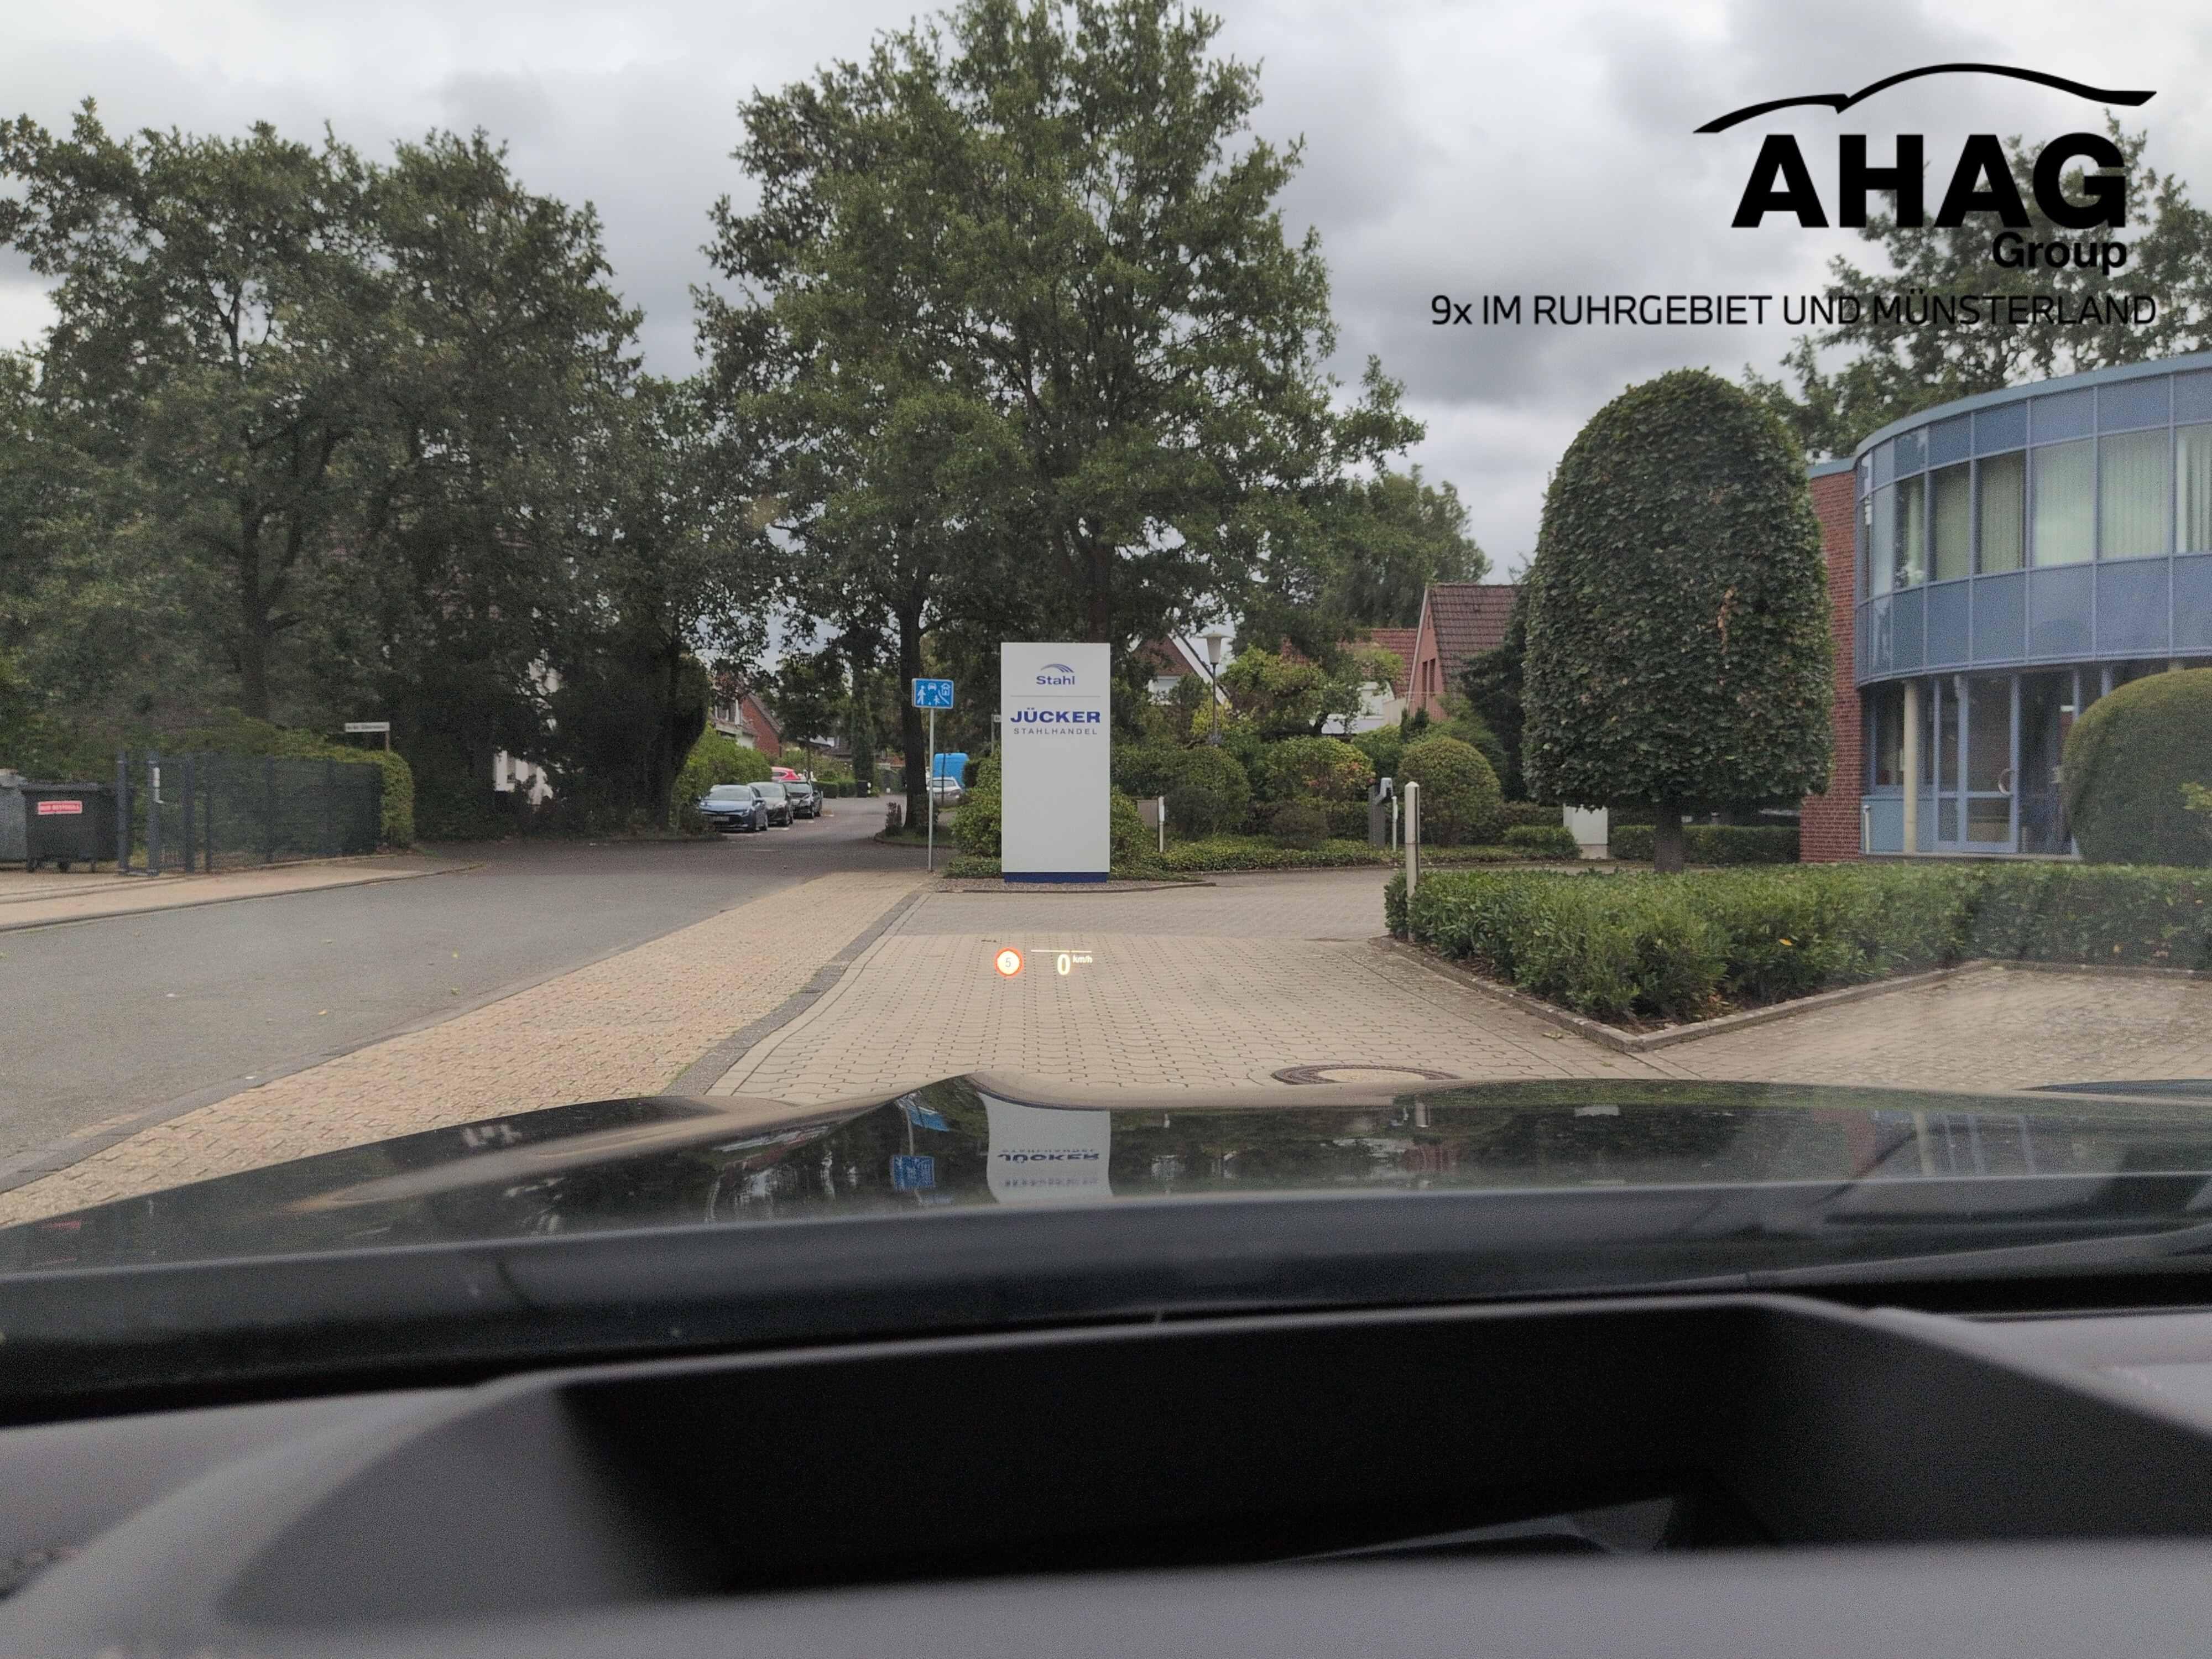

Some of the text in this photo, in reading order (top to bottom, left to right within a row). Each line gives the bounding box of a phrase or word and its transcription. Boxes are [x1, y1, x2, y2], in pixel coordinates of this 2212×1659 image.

[1036, 675, 1076, 685] Stahl
[1010, 707, 1100, 723] JÜCKER
[1005, 957, 1011, 968] 5
[1057, 953, 1093, 975] 0 km/h
